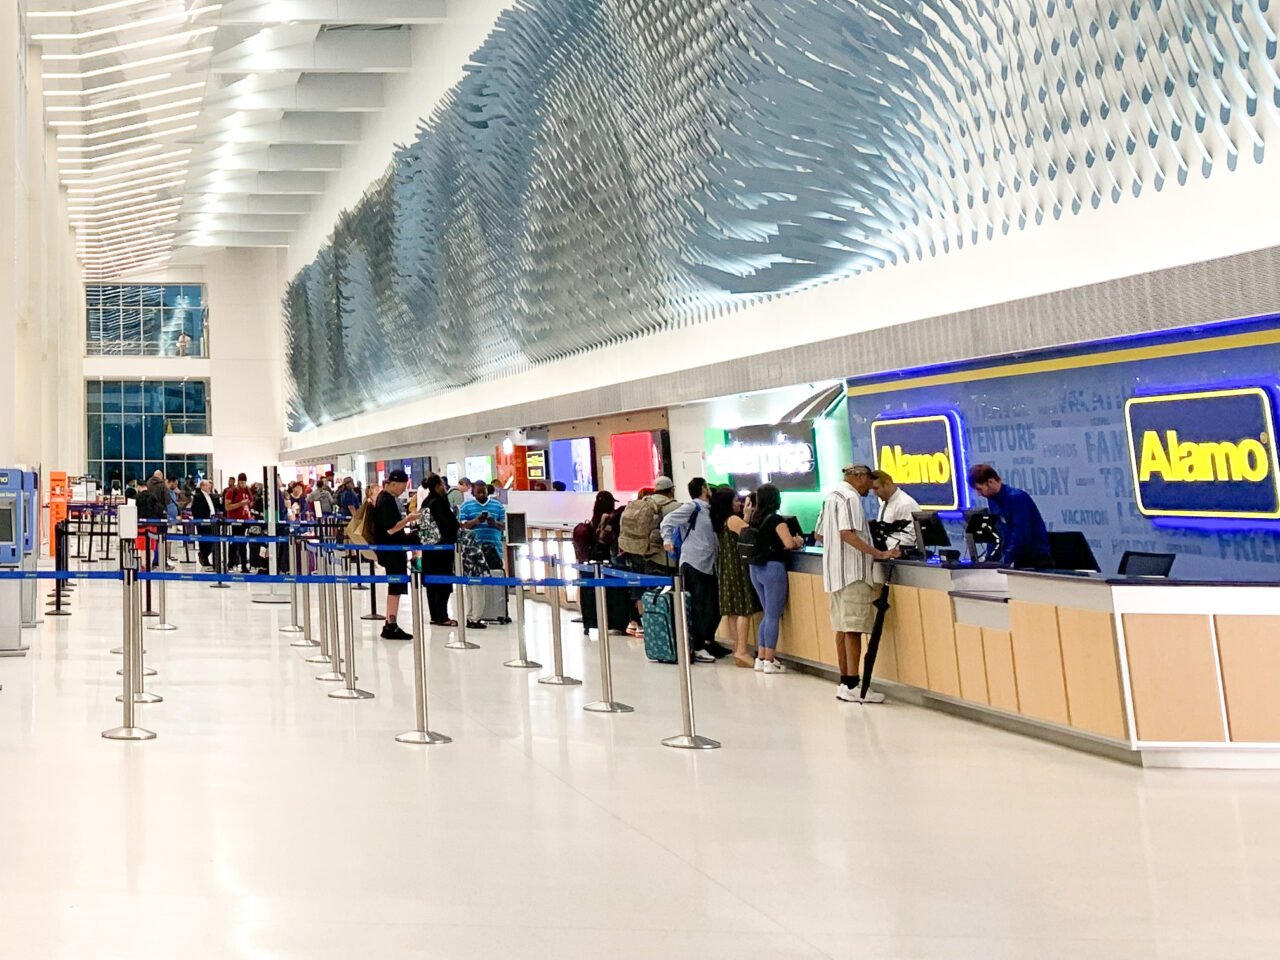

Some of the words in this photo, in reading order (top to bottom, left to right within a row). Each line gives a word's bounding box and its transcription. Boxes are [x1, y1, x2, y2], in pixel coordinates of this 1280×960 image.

[966, 423, 1036, 453] VENTURE
[880, 444, 951, 484] Alamo
[1139, 429, 1270, 483] Alamo
[1061, 509, 1109, 526] VACATION
